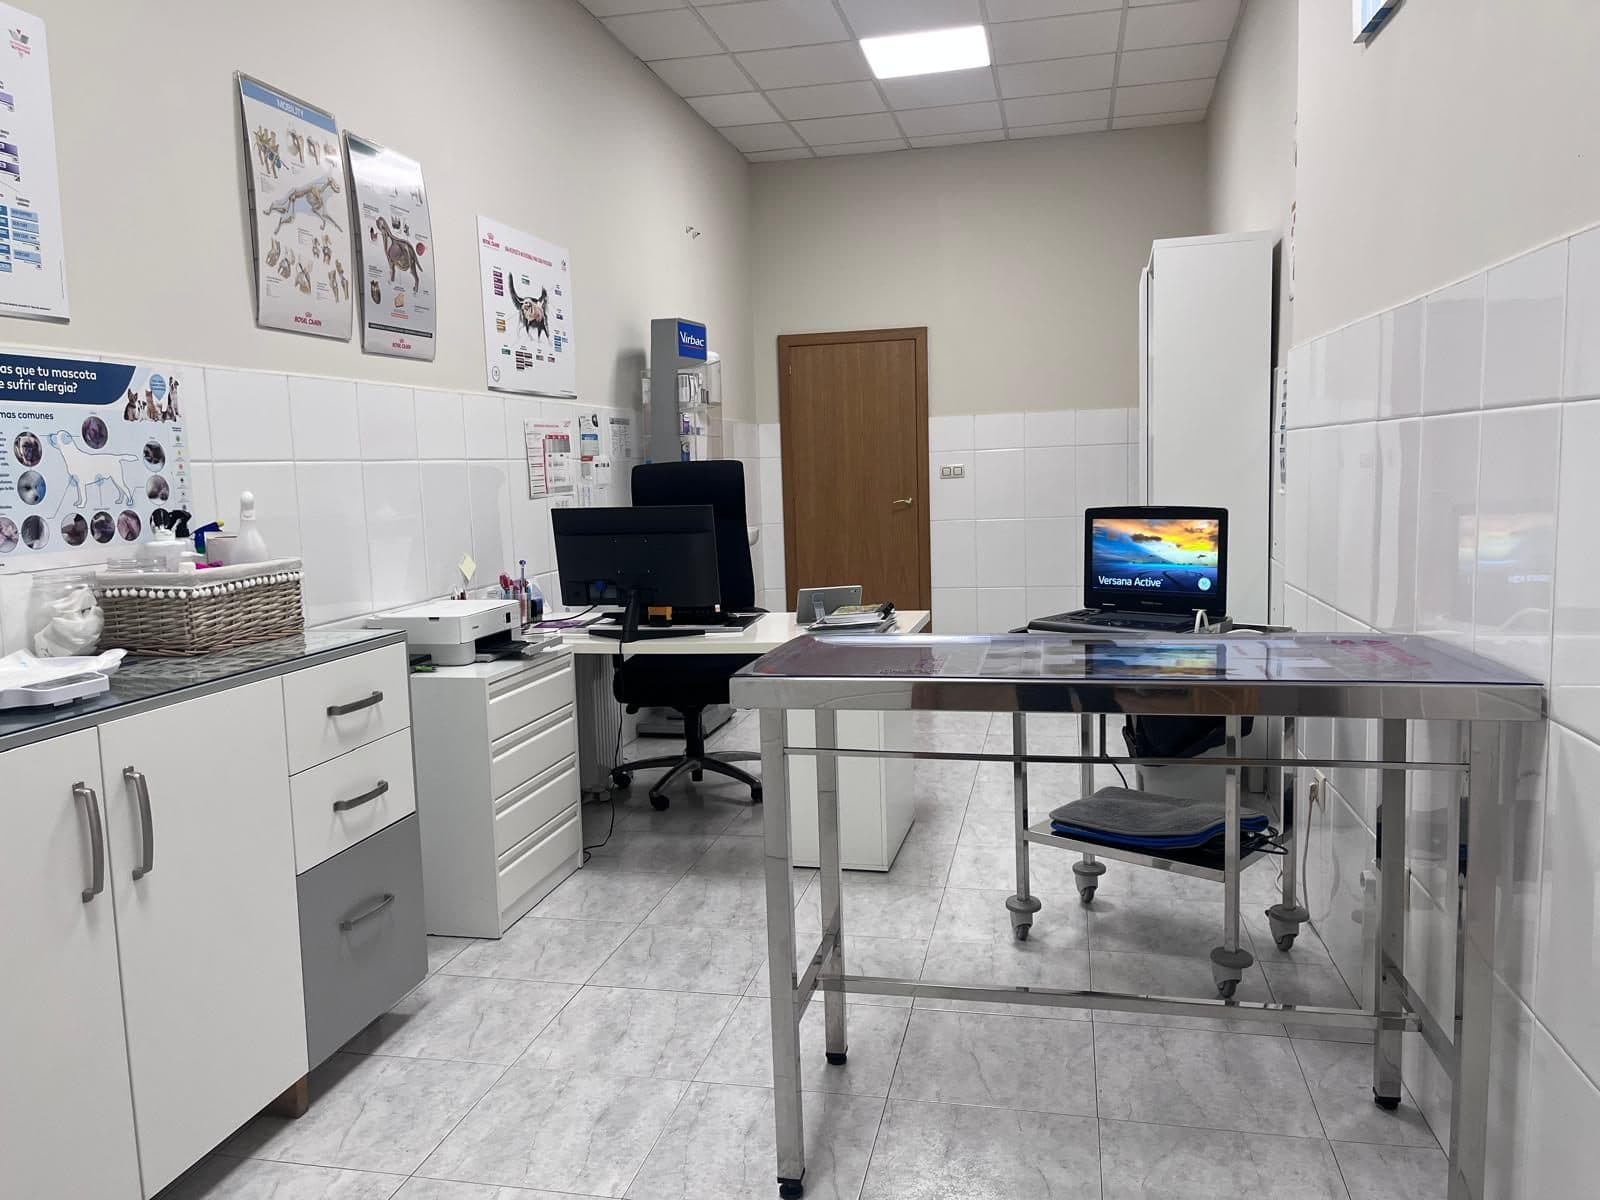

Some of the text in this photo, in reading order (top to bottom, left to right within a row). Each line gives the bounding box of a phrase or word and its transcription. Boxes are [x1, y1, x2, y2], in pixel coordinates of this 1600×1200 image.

[680, 331, 704, 346] Virbac
[15, 366, 35, 377] que
[37, 366, 49, 376] tu
[52, 369, 96, 380] mascota
[7, 379, 36, 390] sufrir
[38, 380, 78, 395] alergia?
[18, 412, 54, 420] comunes
[1098, 575, 1161, 587] Versana Active
